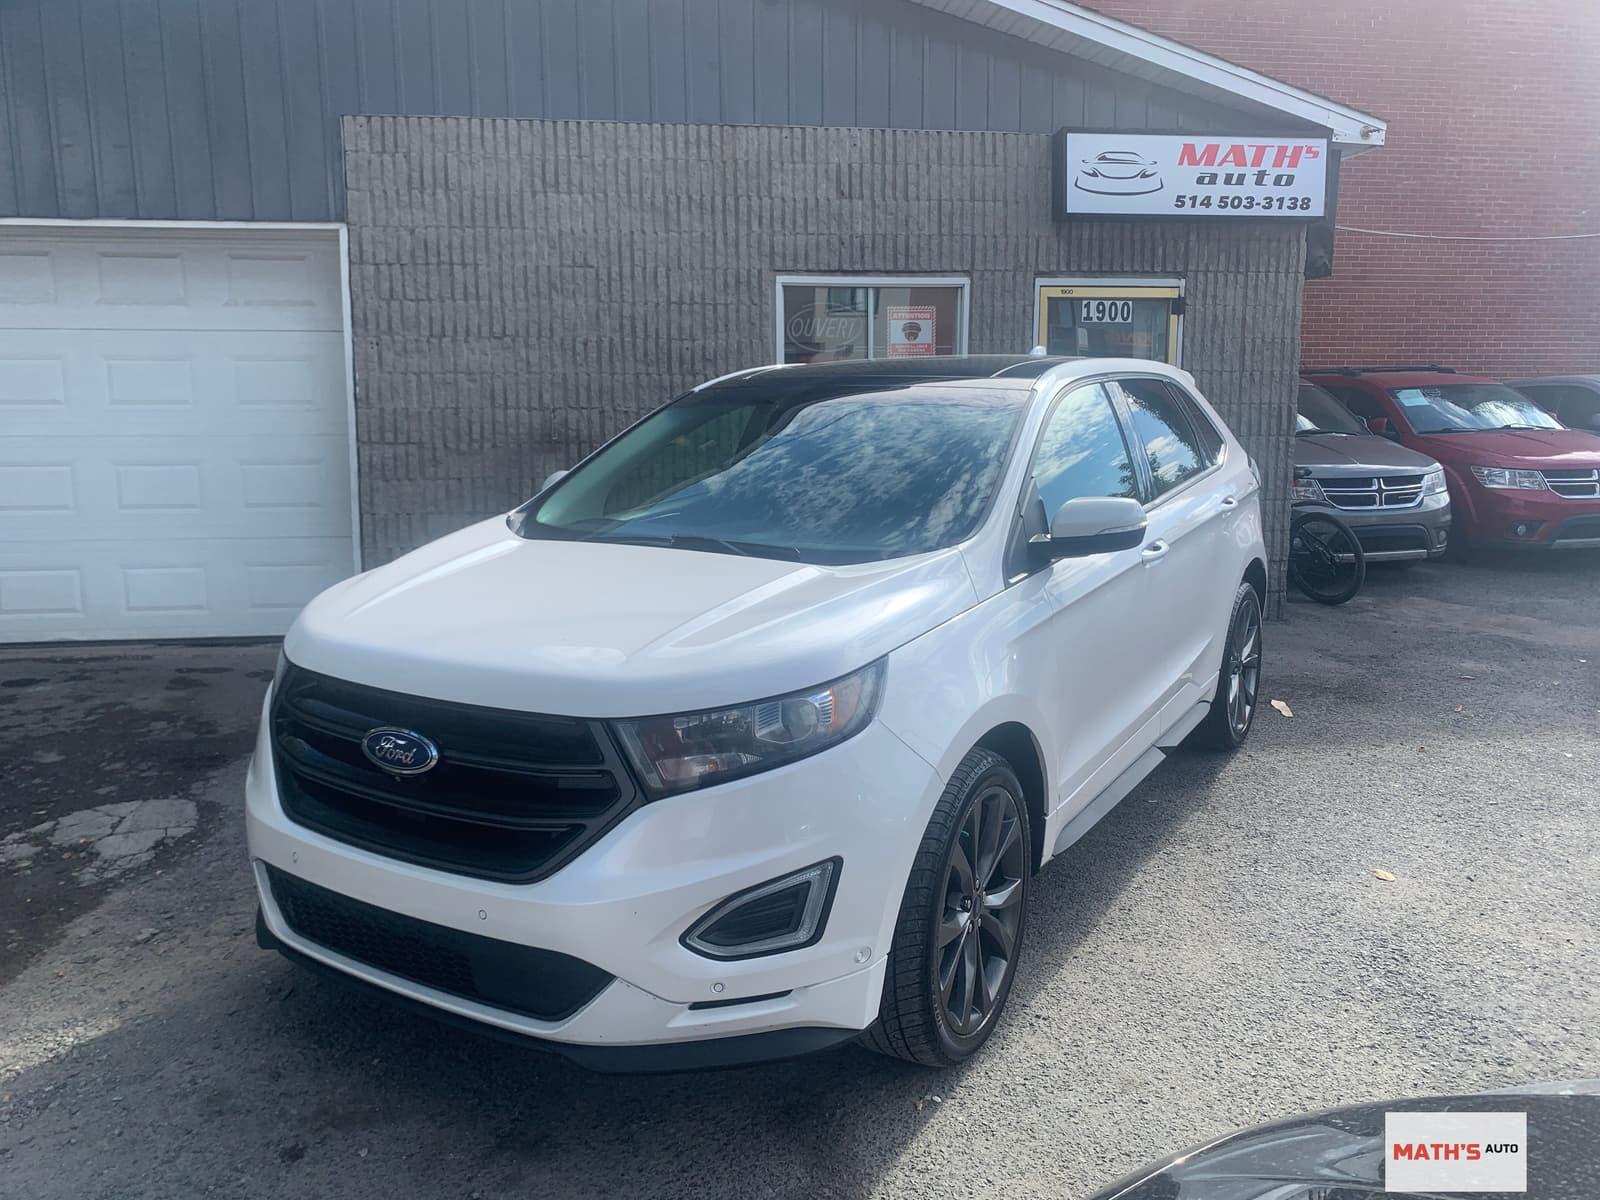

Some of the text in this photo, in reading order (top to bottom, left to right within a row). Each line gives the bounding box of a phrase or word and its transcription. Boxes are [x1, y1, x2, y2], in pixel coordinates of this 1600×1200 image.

[1195, 169, 1296, 187] auto
[1174, 194, 1312, 211] 514 503-3138
[1082, 301, 1131, 322] 1900
[375, 735, 417, 765] Ford
